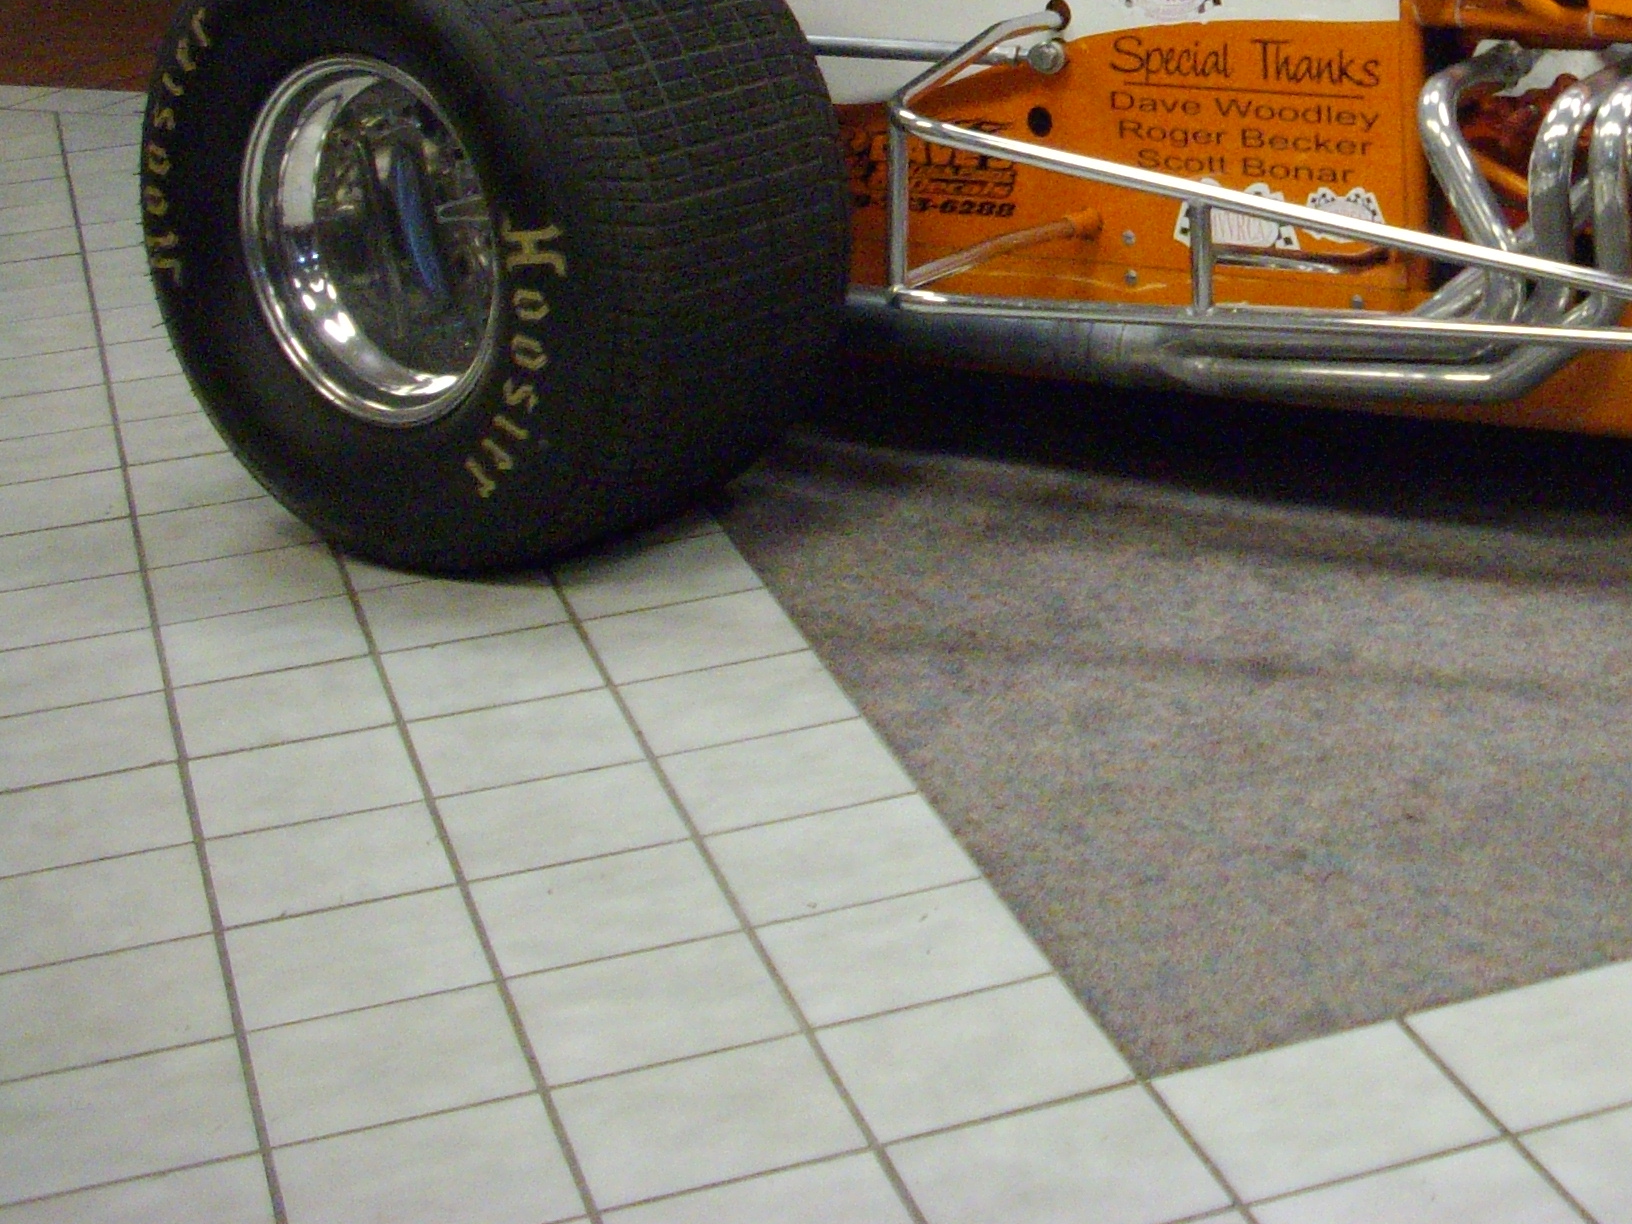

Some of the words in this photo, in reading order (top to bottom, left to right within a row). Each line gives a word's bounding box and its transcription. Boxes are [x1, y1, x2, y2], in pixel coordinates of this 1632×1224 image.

[1109, 35, 1231, 83] Special
[1251, 39, 1381, 88] Thanks
[1109, 91, 1201, 117] Dave
[1215, 97, 1380, 132] Woodley
[1118, 120, 1226, 148] Roger
[1241, 127, 1373, 156] Becker
[1137, 148, 1228, 174] Scott
[1241, 159, 1354, 183] Bonar
